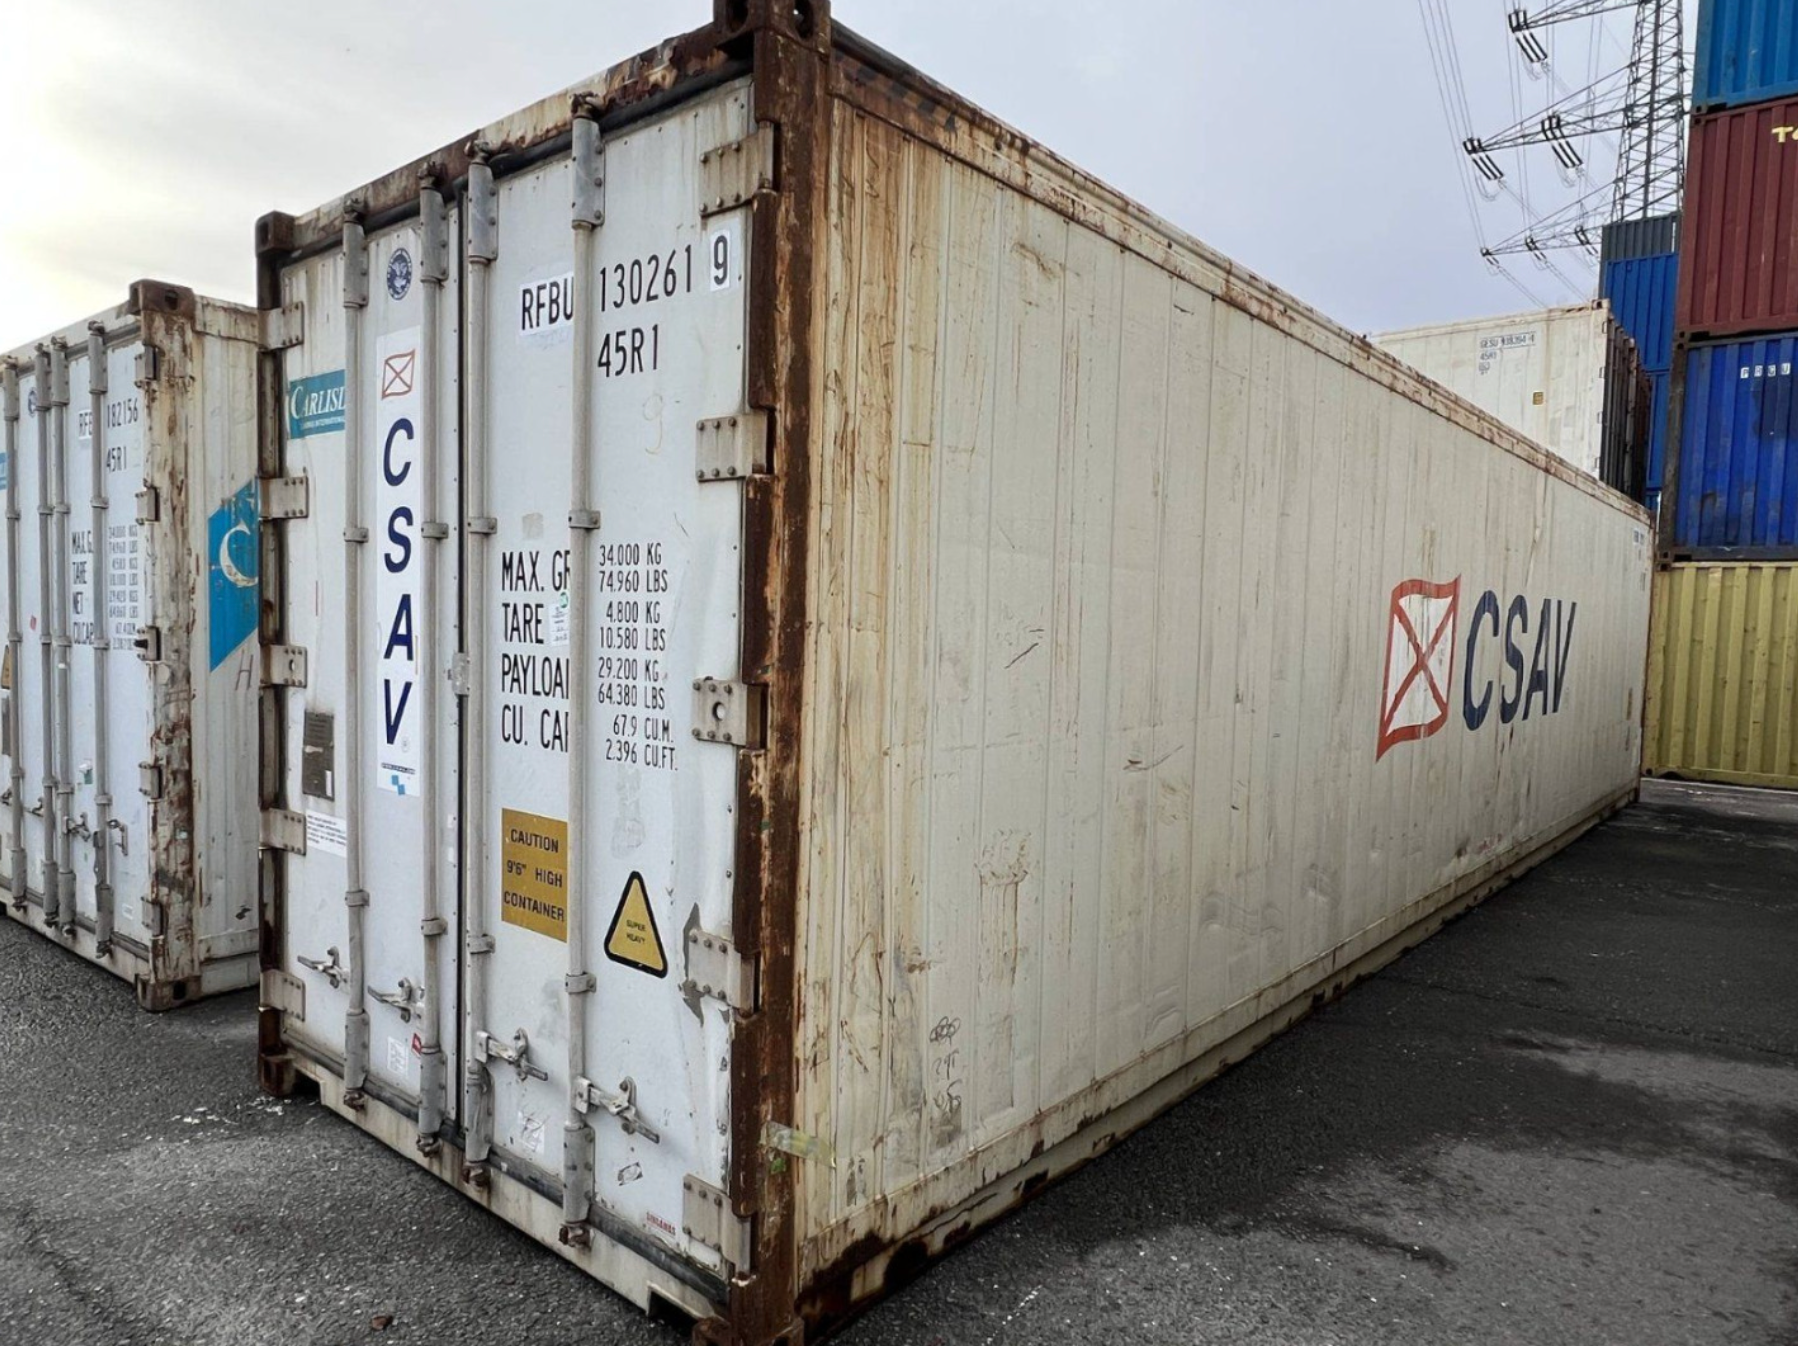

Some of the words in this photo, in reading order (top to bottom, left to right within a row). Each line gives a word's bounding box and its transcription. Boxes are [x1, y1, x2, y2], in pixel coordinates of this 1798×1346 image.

[521, 276, 574, 330] RFBU
[600, 244, 692, 312] 130261
[713, 234, 729, 285] 9
[597, 324, 659, 378] 45R1
[291, 387, 345, 419] CARLISL
[599, 543, 640, 566] 34.000
[646, 543, 662, 565] KG
[501, 550, 544, 592] MAX.
[599, 570, 639, 593] 74.960
[646, 569, 668, 592] LBS
[501, 603, 544, 644] TARE
[606, 601, 639, 623] 4.800
[645, 601, 660, 623] KG
[600, 627, 638, 649] 10.580
[645, 628, 666, 651] LBS
[598, 656, 638, 680] 29.200
[644, 660, 659, 682] KG
[1463, 590, 1577, 731] CSAV
[598, 683, 638, 706] 64.380
[644, 686, 665, 710] LBS
[501, 704, 528, 746] CU.
[613, 714, 637, 737] 67.9
[606, 739, 637, 763] 2.396
[510, 828, 559, 853] CAUTION
[535, 867, 563, 888] HIGH
[504, 890, 564, 922] CONTAINER
